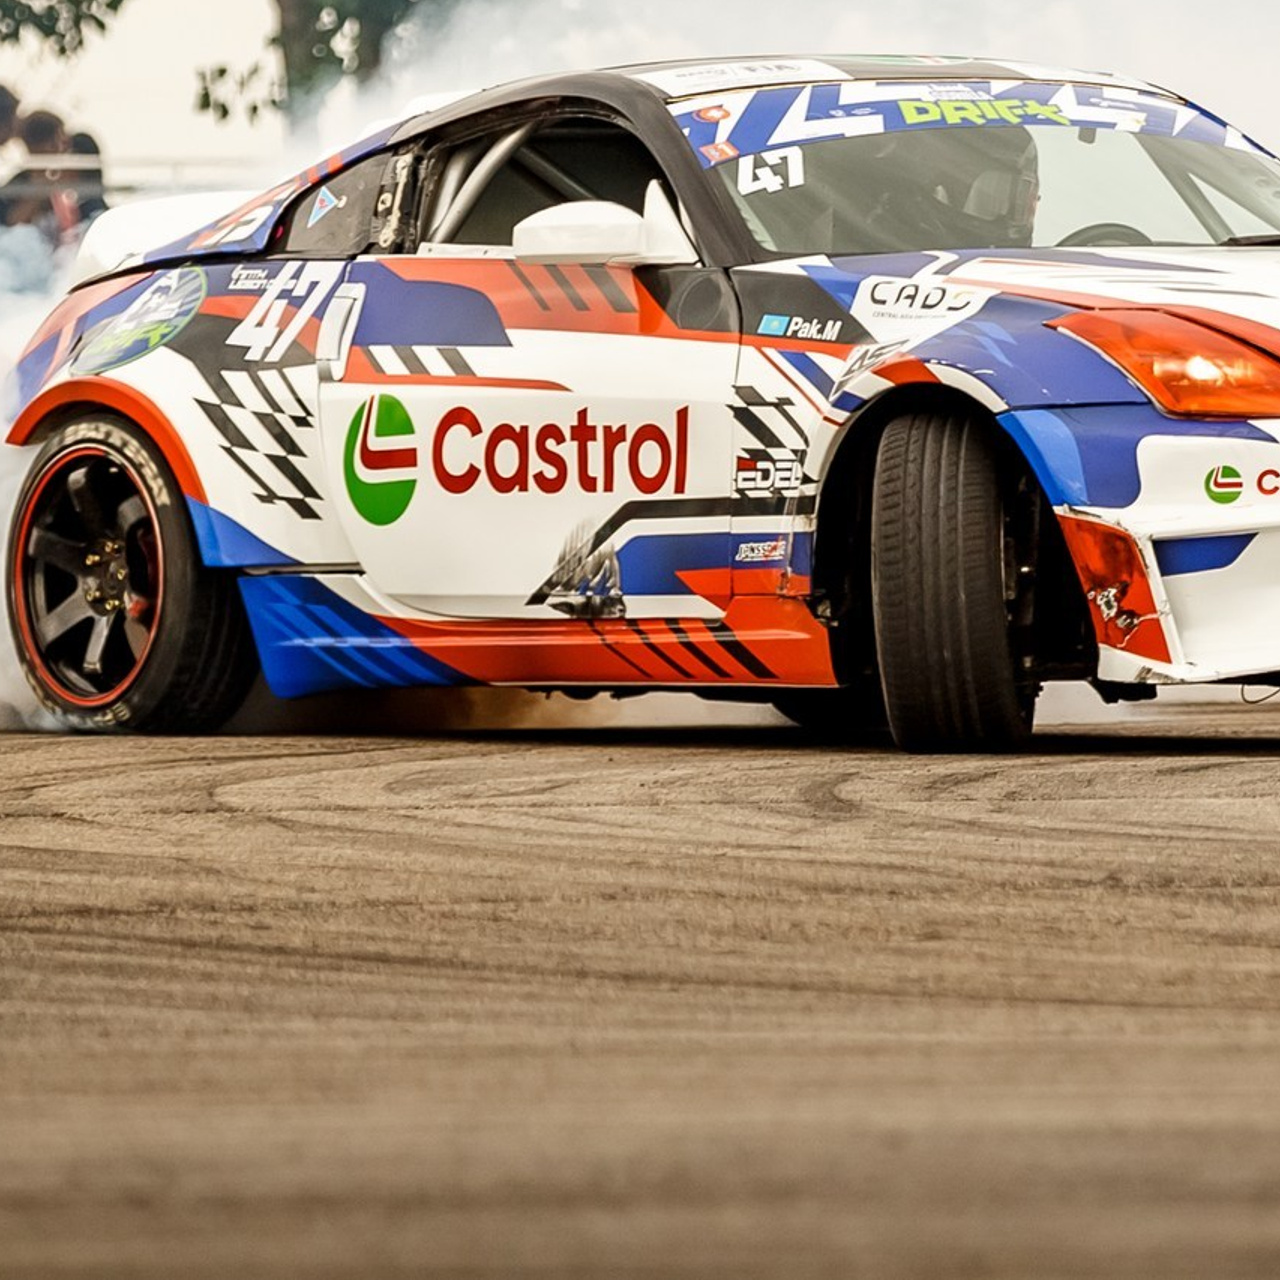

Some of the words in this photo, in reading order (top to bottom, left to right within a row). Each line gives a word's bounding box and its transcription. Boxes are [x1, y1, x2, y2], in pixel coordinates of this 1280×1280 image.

[737, 146, 805, 196] 47
[225, 261, 349, 362] 47
[870, 281, 976, 311] CADS
[787, 317, 842, 342] Pak.M
[433, 405, 689, 495] Castrol
